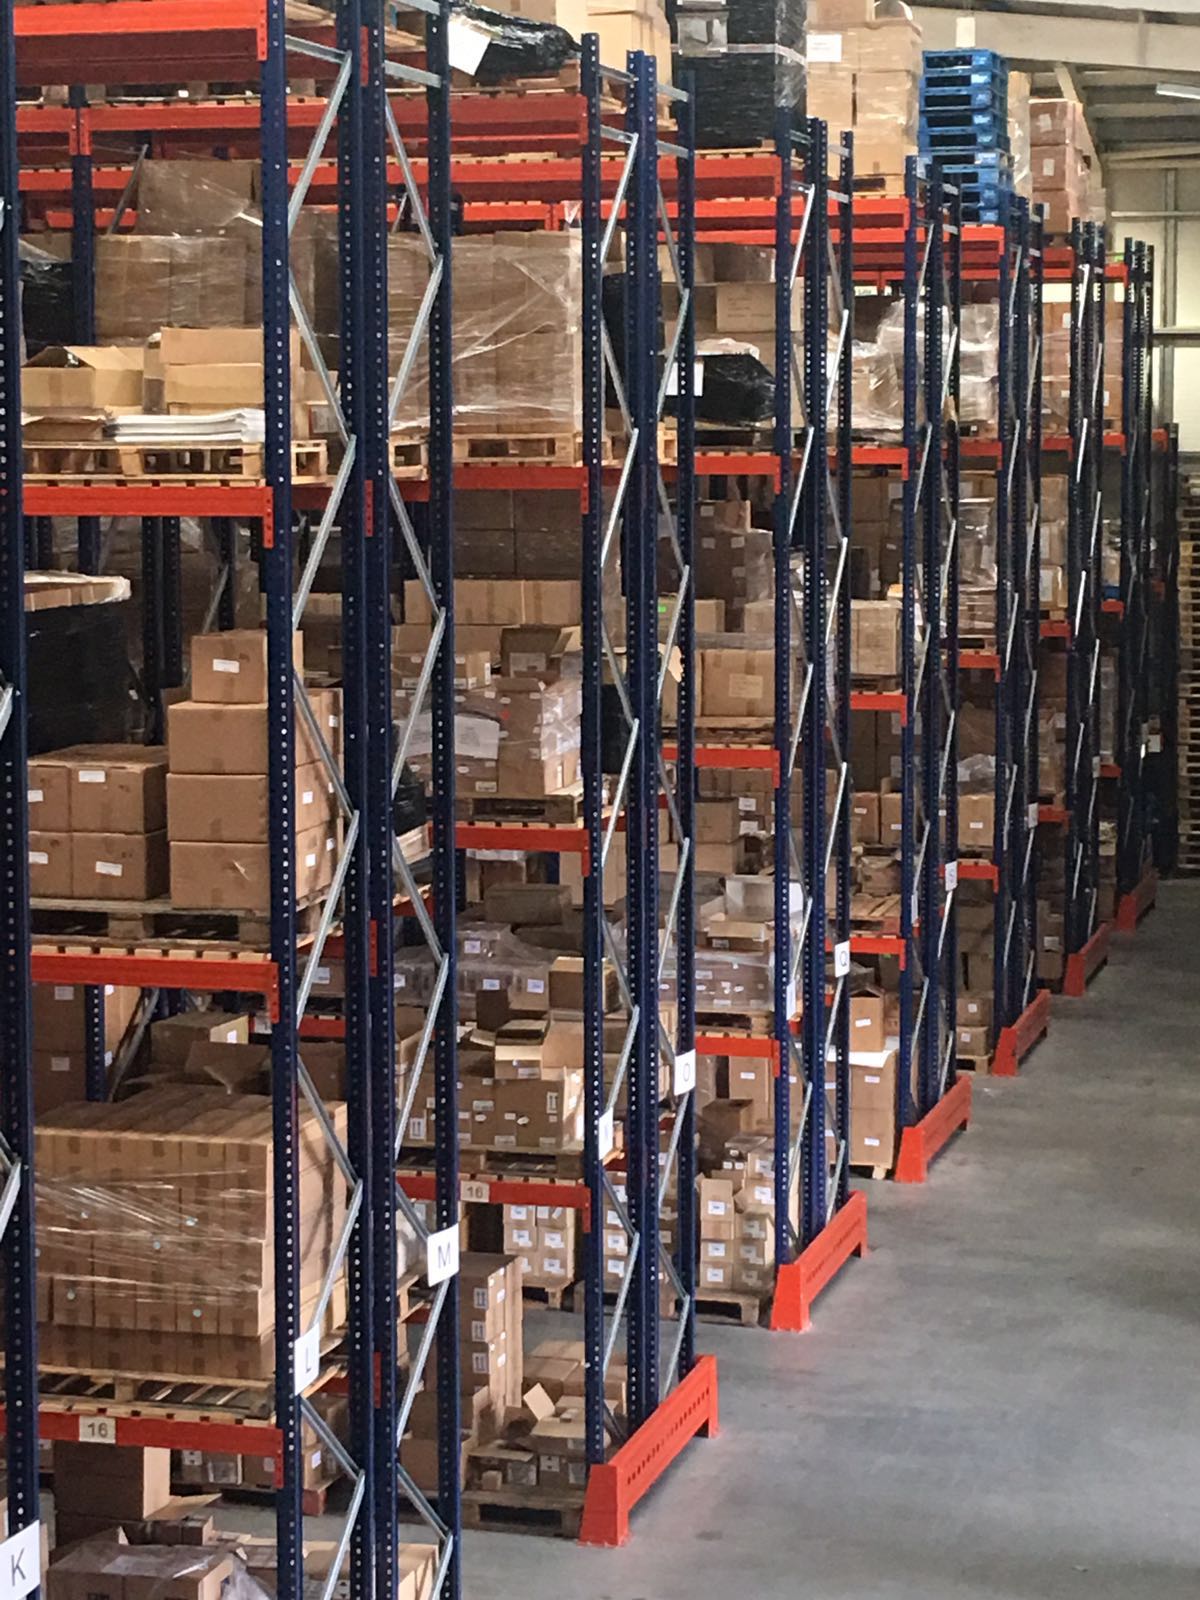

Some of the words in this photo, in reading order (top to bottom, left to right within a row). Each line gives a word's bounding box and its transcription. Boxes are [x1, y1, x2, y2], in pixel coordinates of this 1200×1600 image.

[840, 950, 848, 967] Q
[683, 1062, 690, 1082] O
[466, 1185, 484, 1200] 16
[438, 1241, 451, 1269] M
[305, 1346, 312, 1374] L
[87, 1421, 109, 1439] 16
[11, 1547, 26, 1587] K
